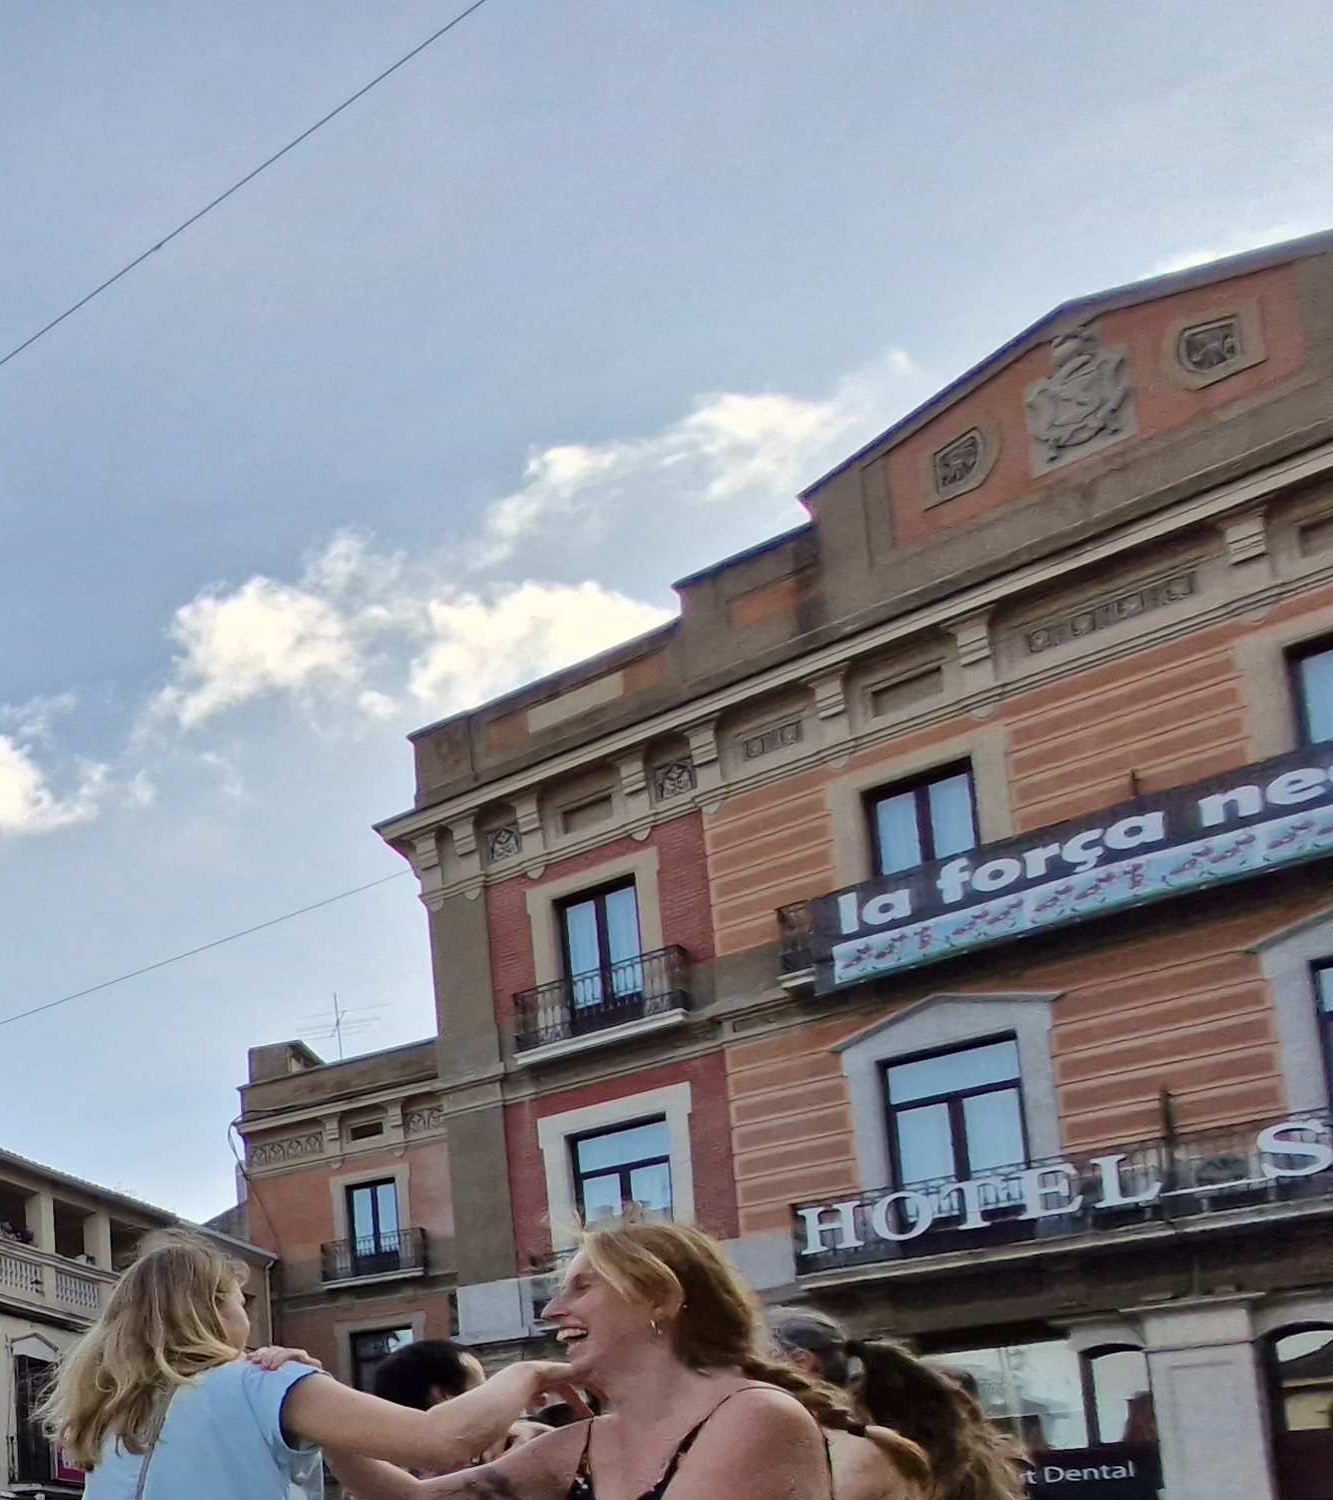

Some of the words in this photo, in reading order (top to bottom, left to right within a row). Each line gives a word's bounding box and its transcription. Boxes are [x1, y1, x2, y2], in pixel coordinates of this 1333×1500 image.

[837, 888, 912, 935] la
[936, 810, 1165, 904] força
[1197, 766, 1333, 828] ne
[797, 1153, 1164, 1255] HOTEL
[1043, 1460, 1135, 1483] Dental
